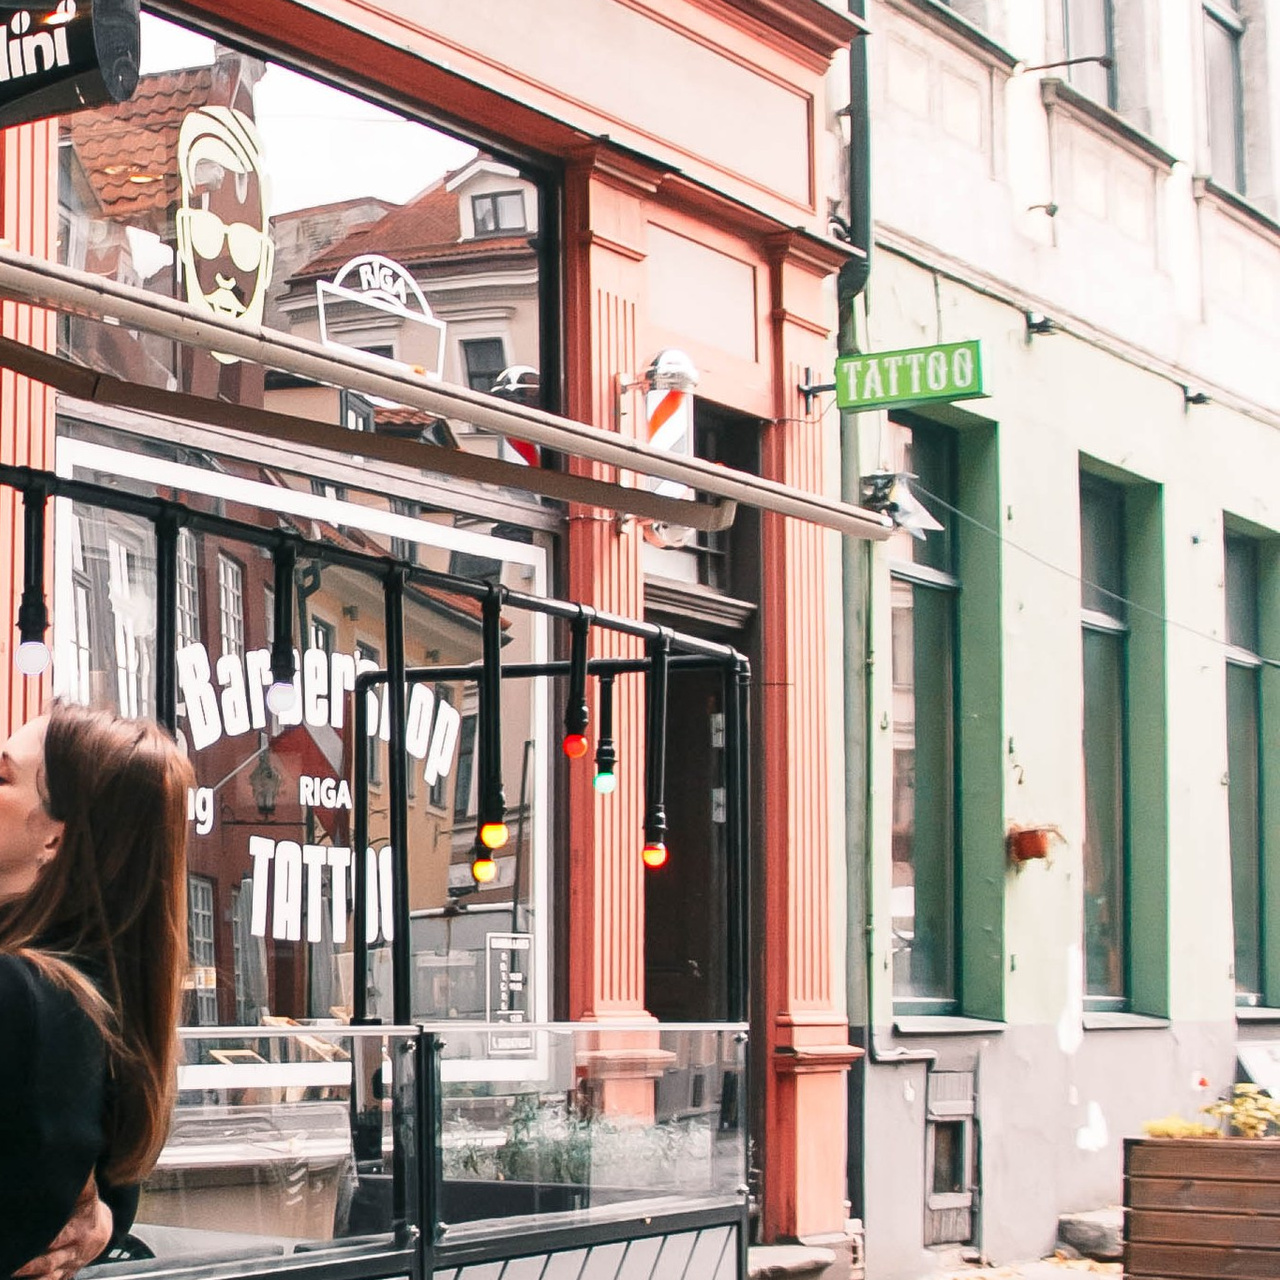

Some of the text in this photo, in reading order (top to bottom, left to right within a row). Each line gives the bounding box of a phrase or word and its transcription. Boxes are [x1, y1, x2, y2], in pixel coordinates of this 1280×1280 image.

[359, 261, 408, 304] RIGA
[843, 347, 974, 401] TATTOO
[299, 775, 353, 810] RIGA
